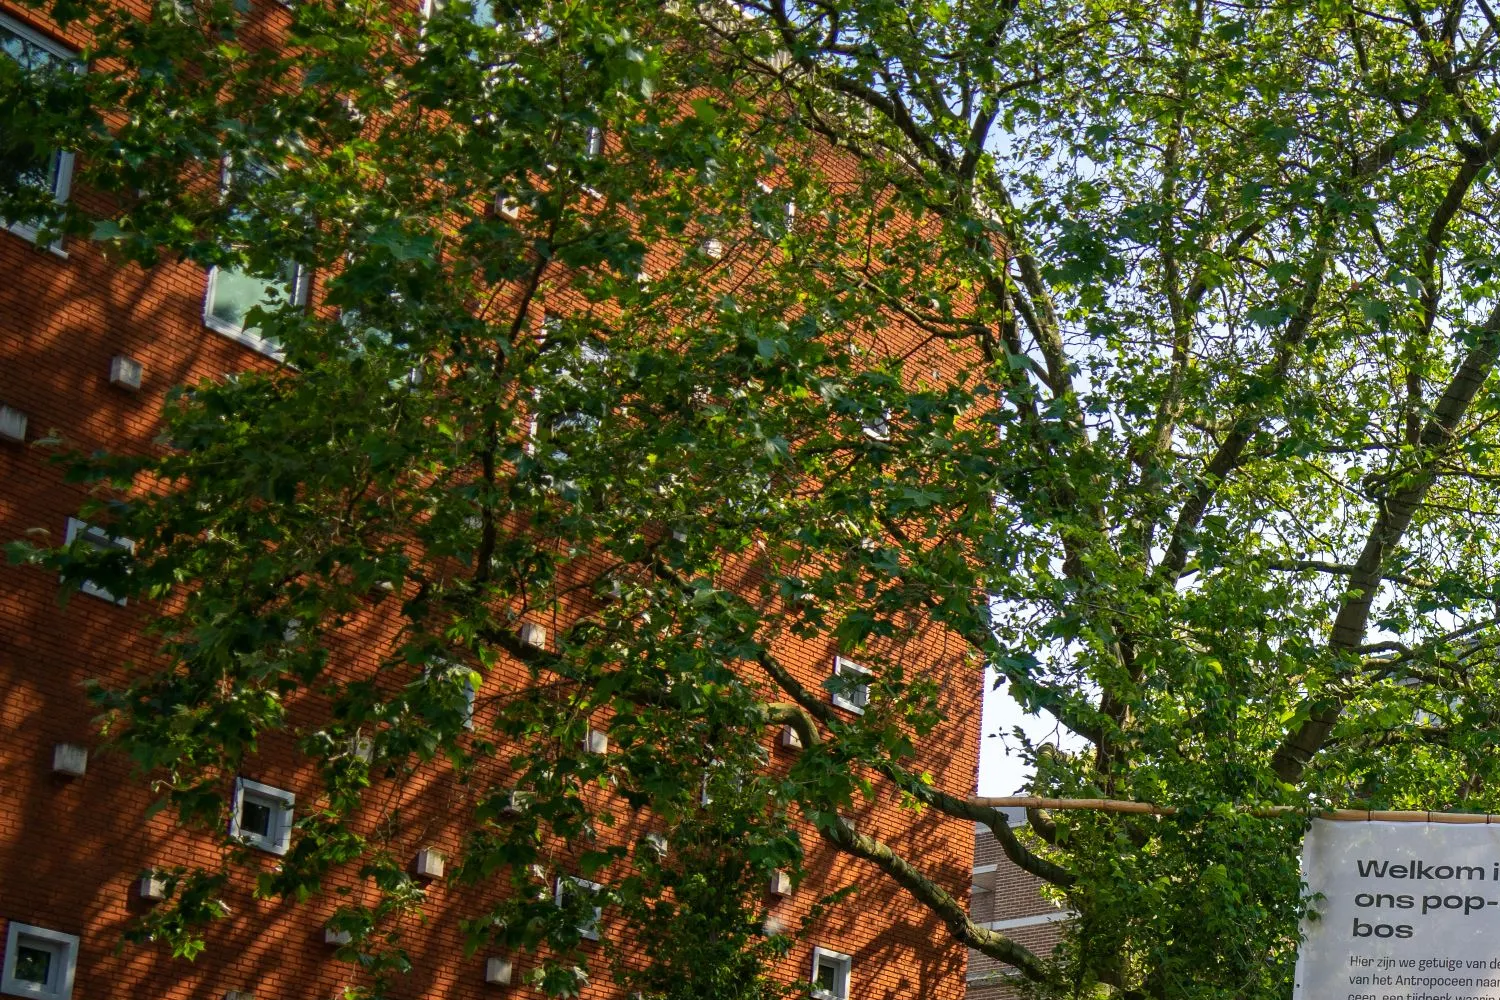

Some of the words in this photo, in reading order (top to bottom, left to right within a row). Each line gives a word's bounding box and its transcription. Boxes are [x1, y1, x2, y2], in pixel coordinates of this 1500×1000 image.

[1357, 860, 1485, 881] Welkom
[1355, 893, 1414, 909] ons
[1352, 918, 1413, 938] bos
[1350, 955, 1374, 966] Hier
[1376, 957, 1395, 971] zijn
[1398, 960, 1415, 969] we
[1418, 958, 1462, 972] getuige
[1465, 960, 1486, 969] van
[1349, 976, 1369, 985] van
[1372, 974, 1392, 985] het
[1395, 974, 1472, 989] Antropoceen
